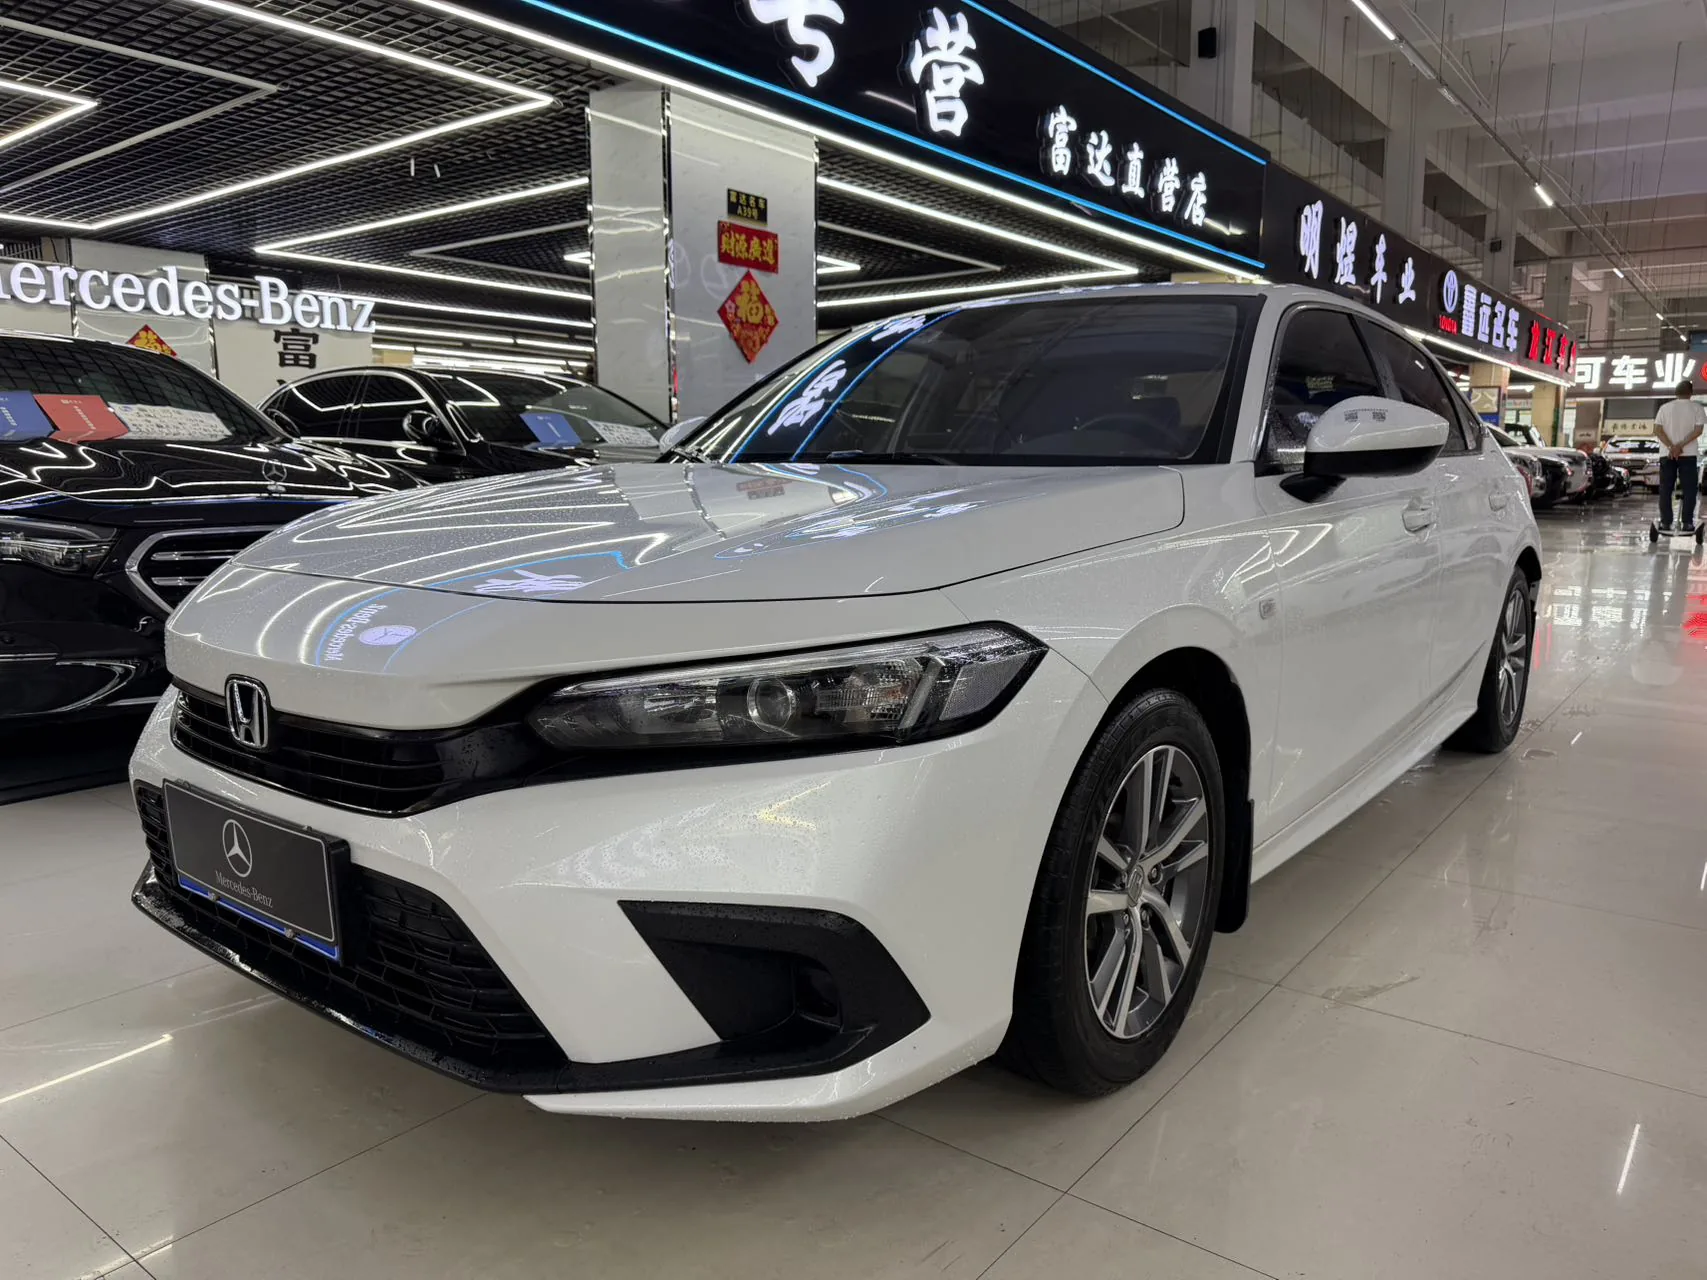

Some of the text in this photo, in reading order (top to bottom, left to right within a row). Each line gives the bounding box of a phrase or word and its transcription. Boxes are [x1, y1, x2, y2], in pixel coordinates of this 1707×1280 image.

[1049, 105, 1208, 227] 富达直营店
[0, 262, 376, 333] ercedes-Benz
[215, 870, 274, 908] Mercedes-Benz
